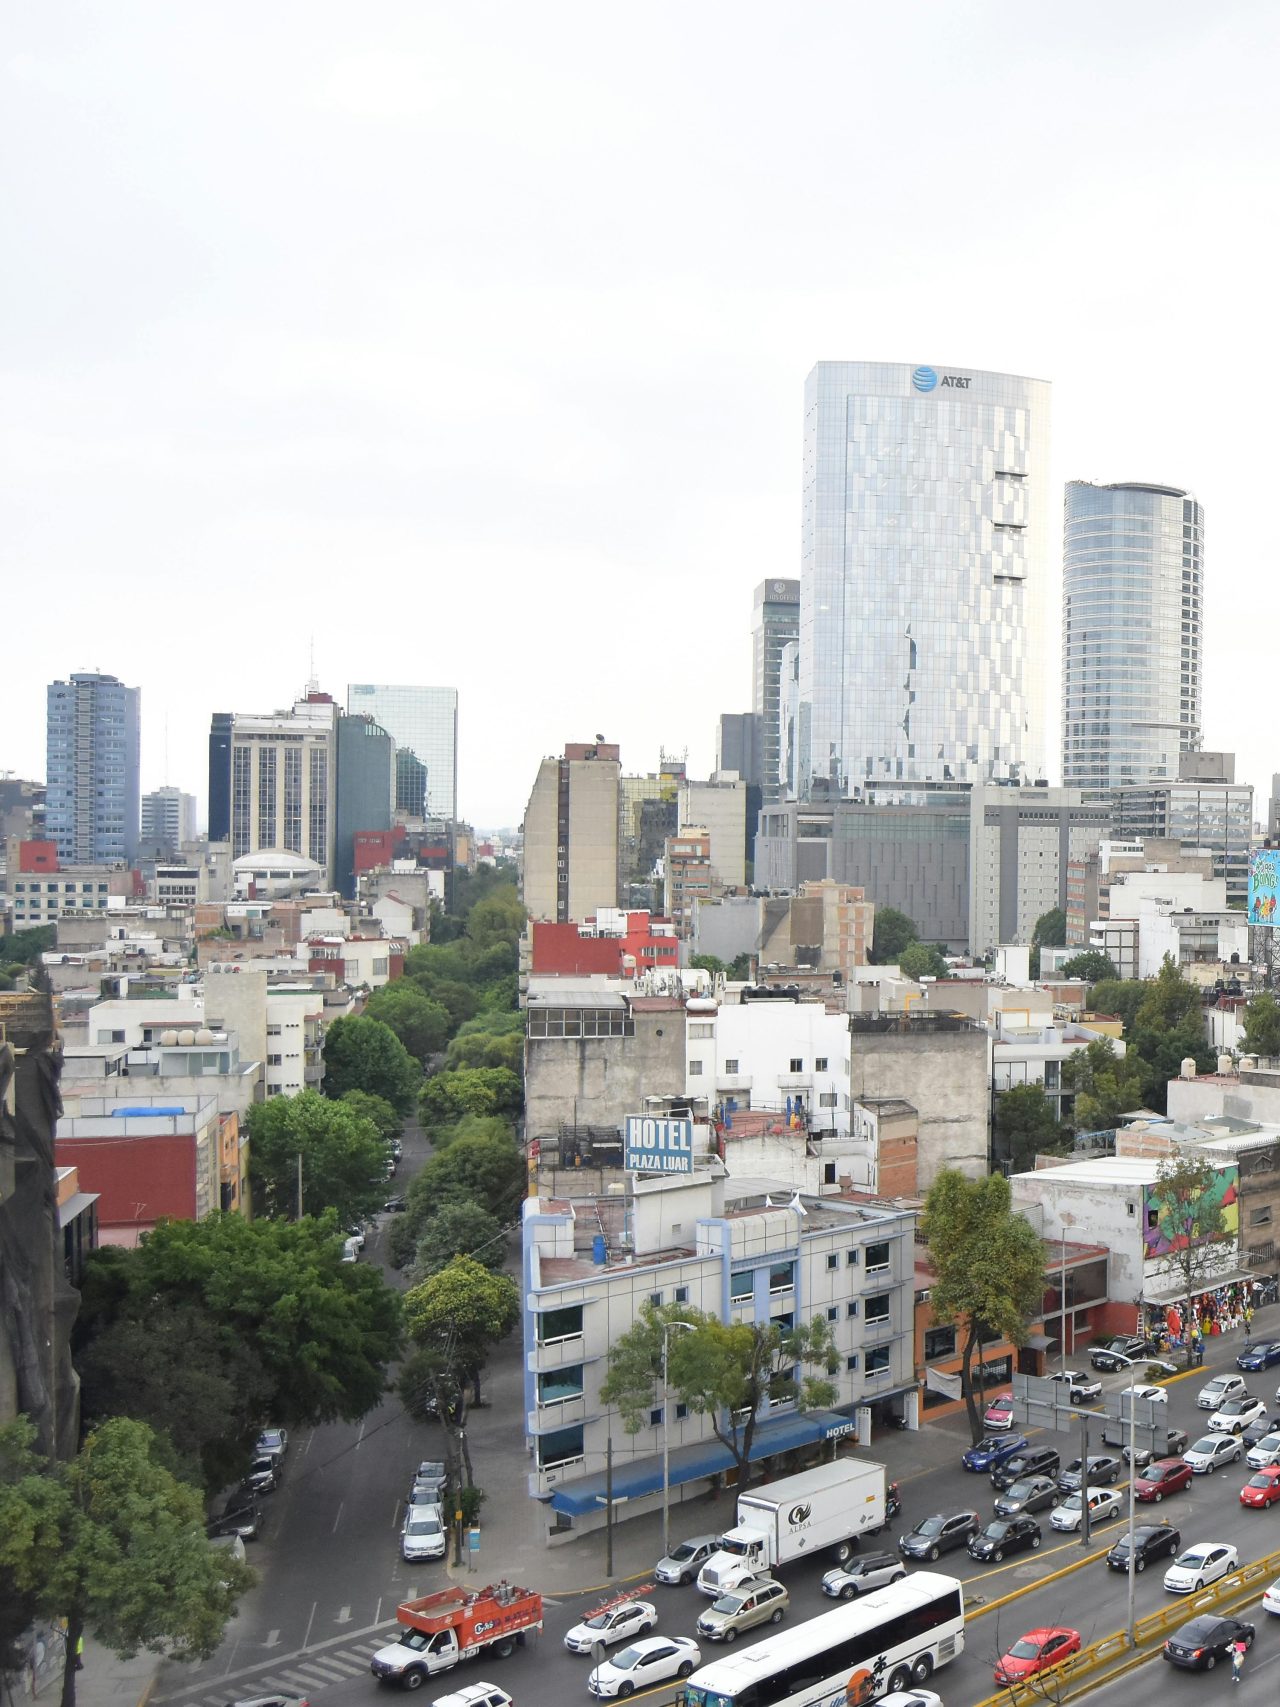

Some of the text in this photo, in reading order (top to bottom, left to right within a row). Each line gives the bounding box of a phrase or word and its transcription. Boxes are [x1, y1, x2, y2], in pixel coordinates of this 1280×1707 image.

[941, 375, 972, 389] AT&T
[629, 1118, 691, 1151] HOTEL
[629, 1154, 689, 1171] PLAZA LUAR
[826, 1422, 855, 1438] HOTEL
[789, 1520, 812, 1534] ALPSA
